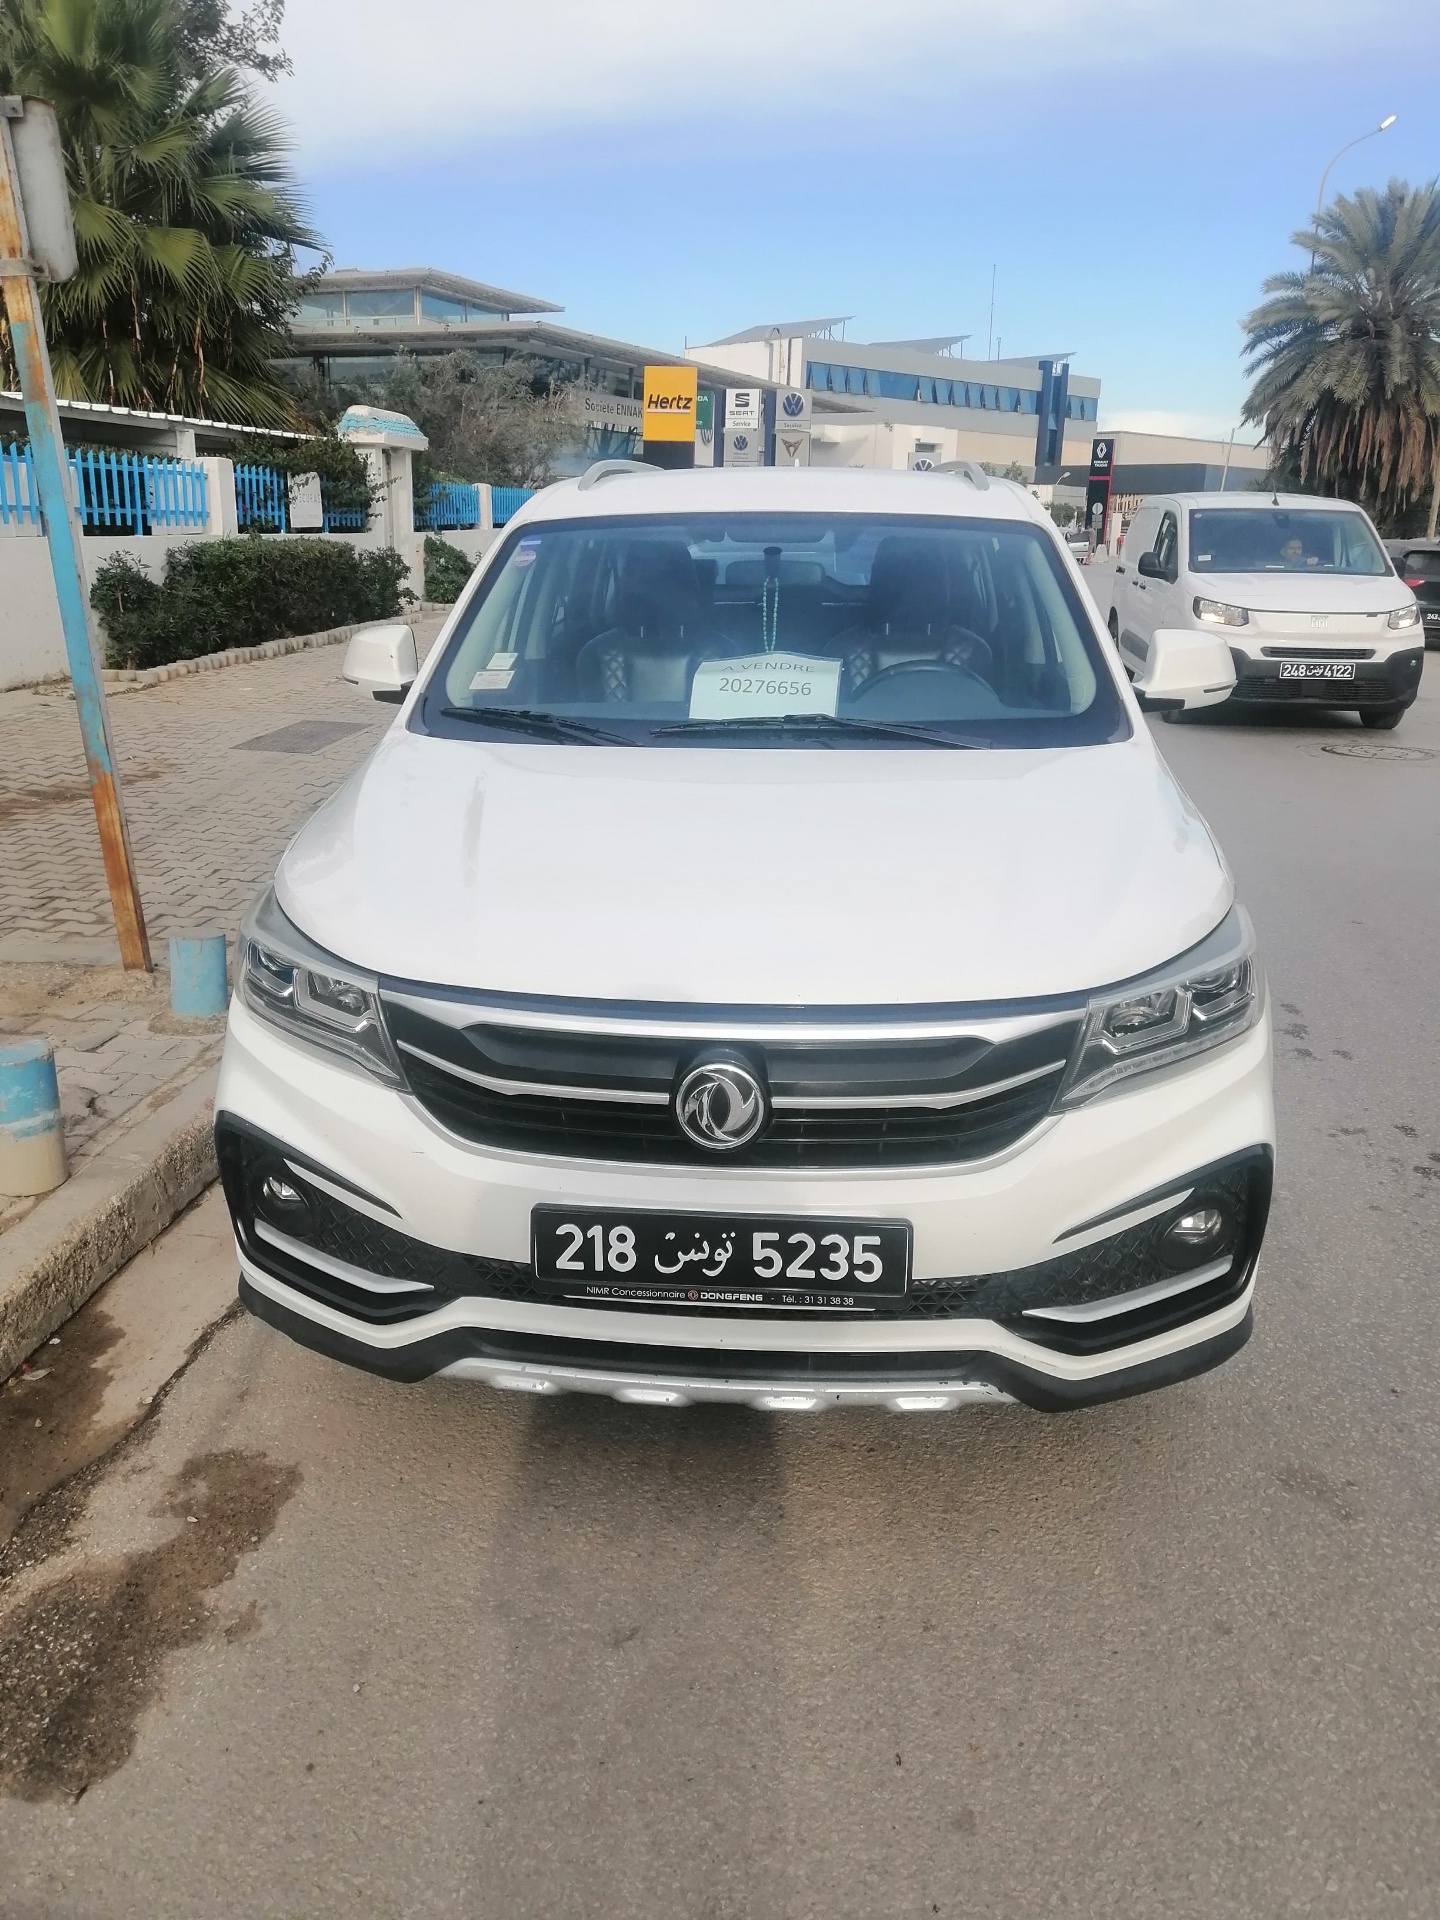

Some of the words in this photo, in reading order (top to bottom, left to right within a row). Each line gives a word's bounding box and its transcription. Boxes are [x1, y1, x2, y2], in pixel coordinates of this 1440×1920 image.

[647, 394, 693, 409] Hertz
[740, 662, 815, 672] VENDRE
[1282, 664, 1306, 677] 248
[1324, 665, 1352, 677] 4122
[719, 677, 812, 696] 20276656
[555, 1223, 637, 1273] 218
[654, 1231, 736, 1277] تونس
[752, 1231, 883, 1283] 5235
[586, 1286, 610, 1295] NIMR
[611, 1287, 686, 1299] Concessionnaire
[700, 1291, 763, 1301] DONGFENG
[804, 1295, 814, 1304] 31
[817, 1296, 827, 1304] 31
[830, 1296, 841, 1305] 38
[843, 1297, 854, 1306] 38
